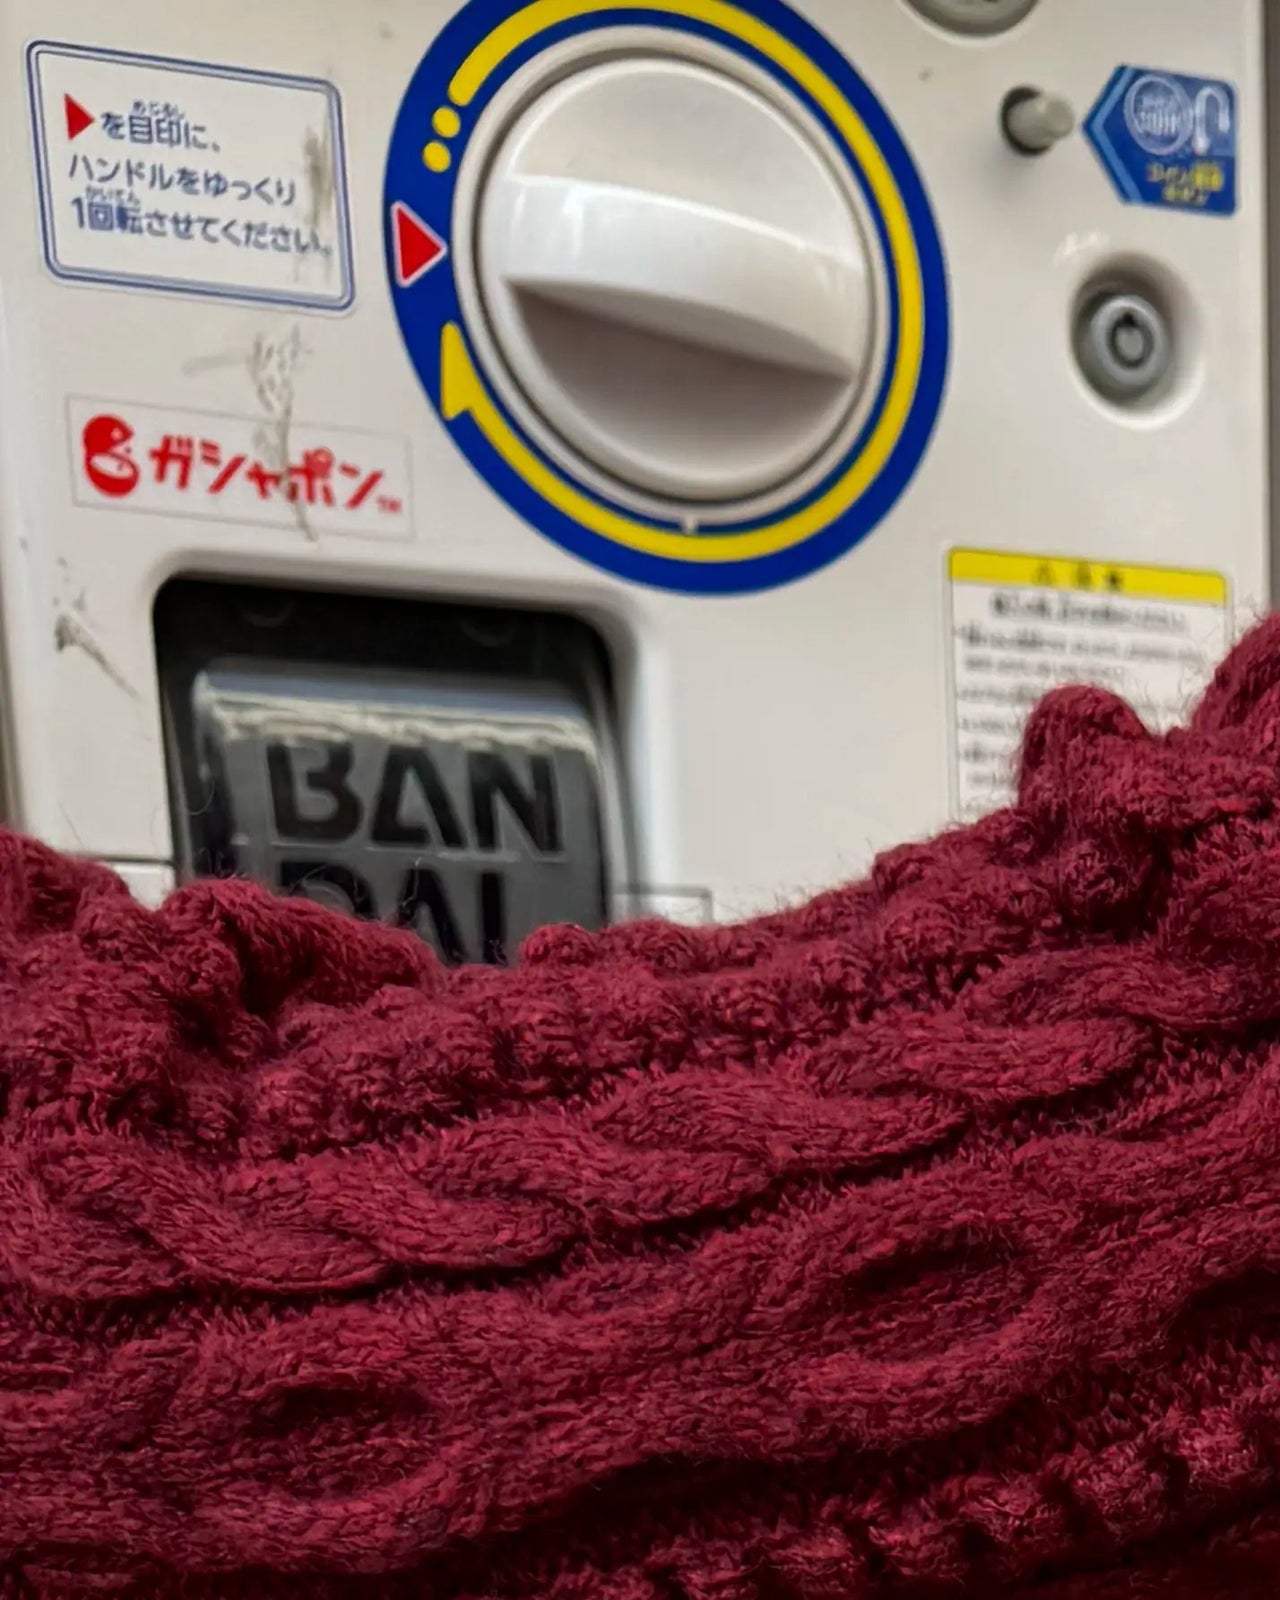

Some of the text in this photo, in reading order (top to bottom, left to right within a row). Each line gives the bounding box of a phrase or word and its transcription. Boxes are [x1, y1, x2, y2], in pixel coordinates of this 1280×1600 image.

[101, 111, 220, 152] を目印に、
[69, 154, 296, 206] ハンドルをゆっくり
[150, 434, 384, 510] ガシャポン
[266, 742, 564, 853] BAN
